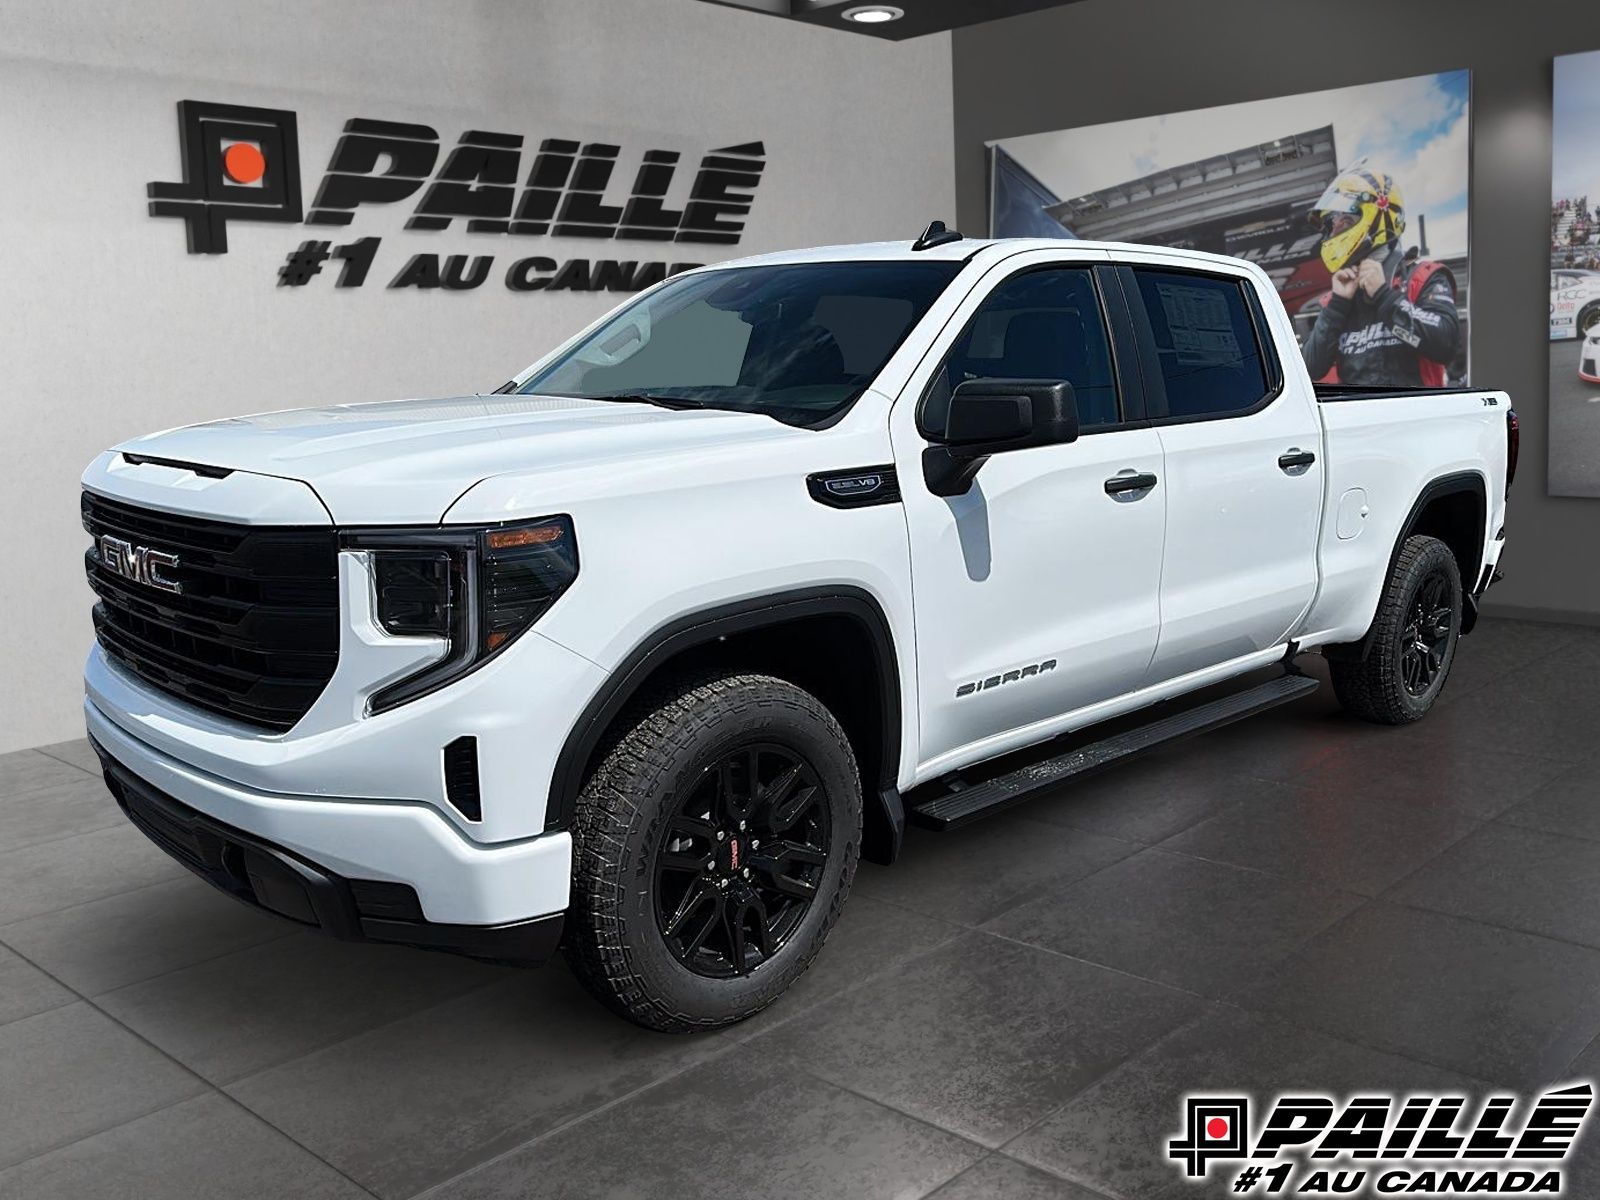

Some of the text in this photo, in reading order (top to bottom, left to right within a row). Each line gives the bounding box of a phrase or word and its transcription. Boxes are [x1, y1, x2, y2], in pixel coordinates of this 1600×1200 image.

[304, 117, 766, 245] PAILLÉ
[276, 236, 708, 293] #1 AU CANA
[101, 534, 183, 594] GMC
[955, 659, 1057, 698] SIERRA
